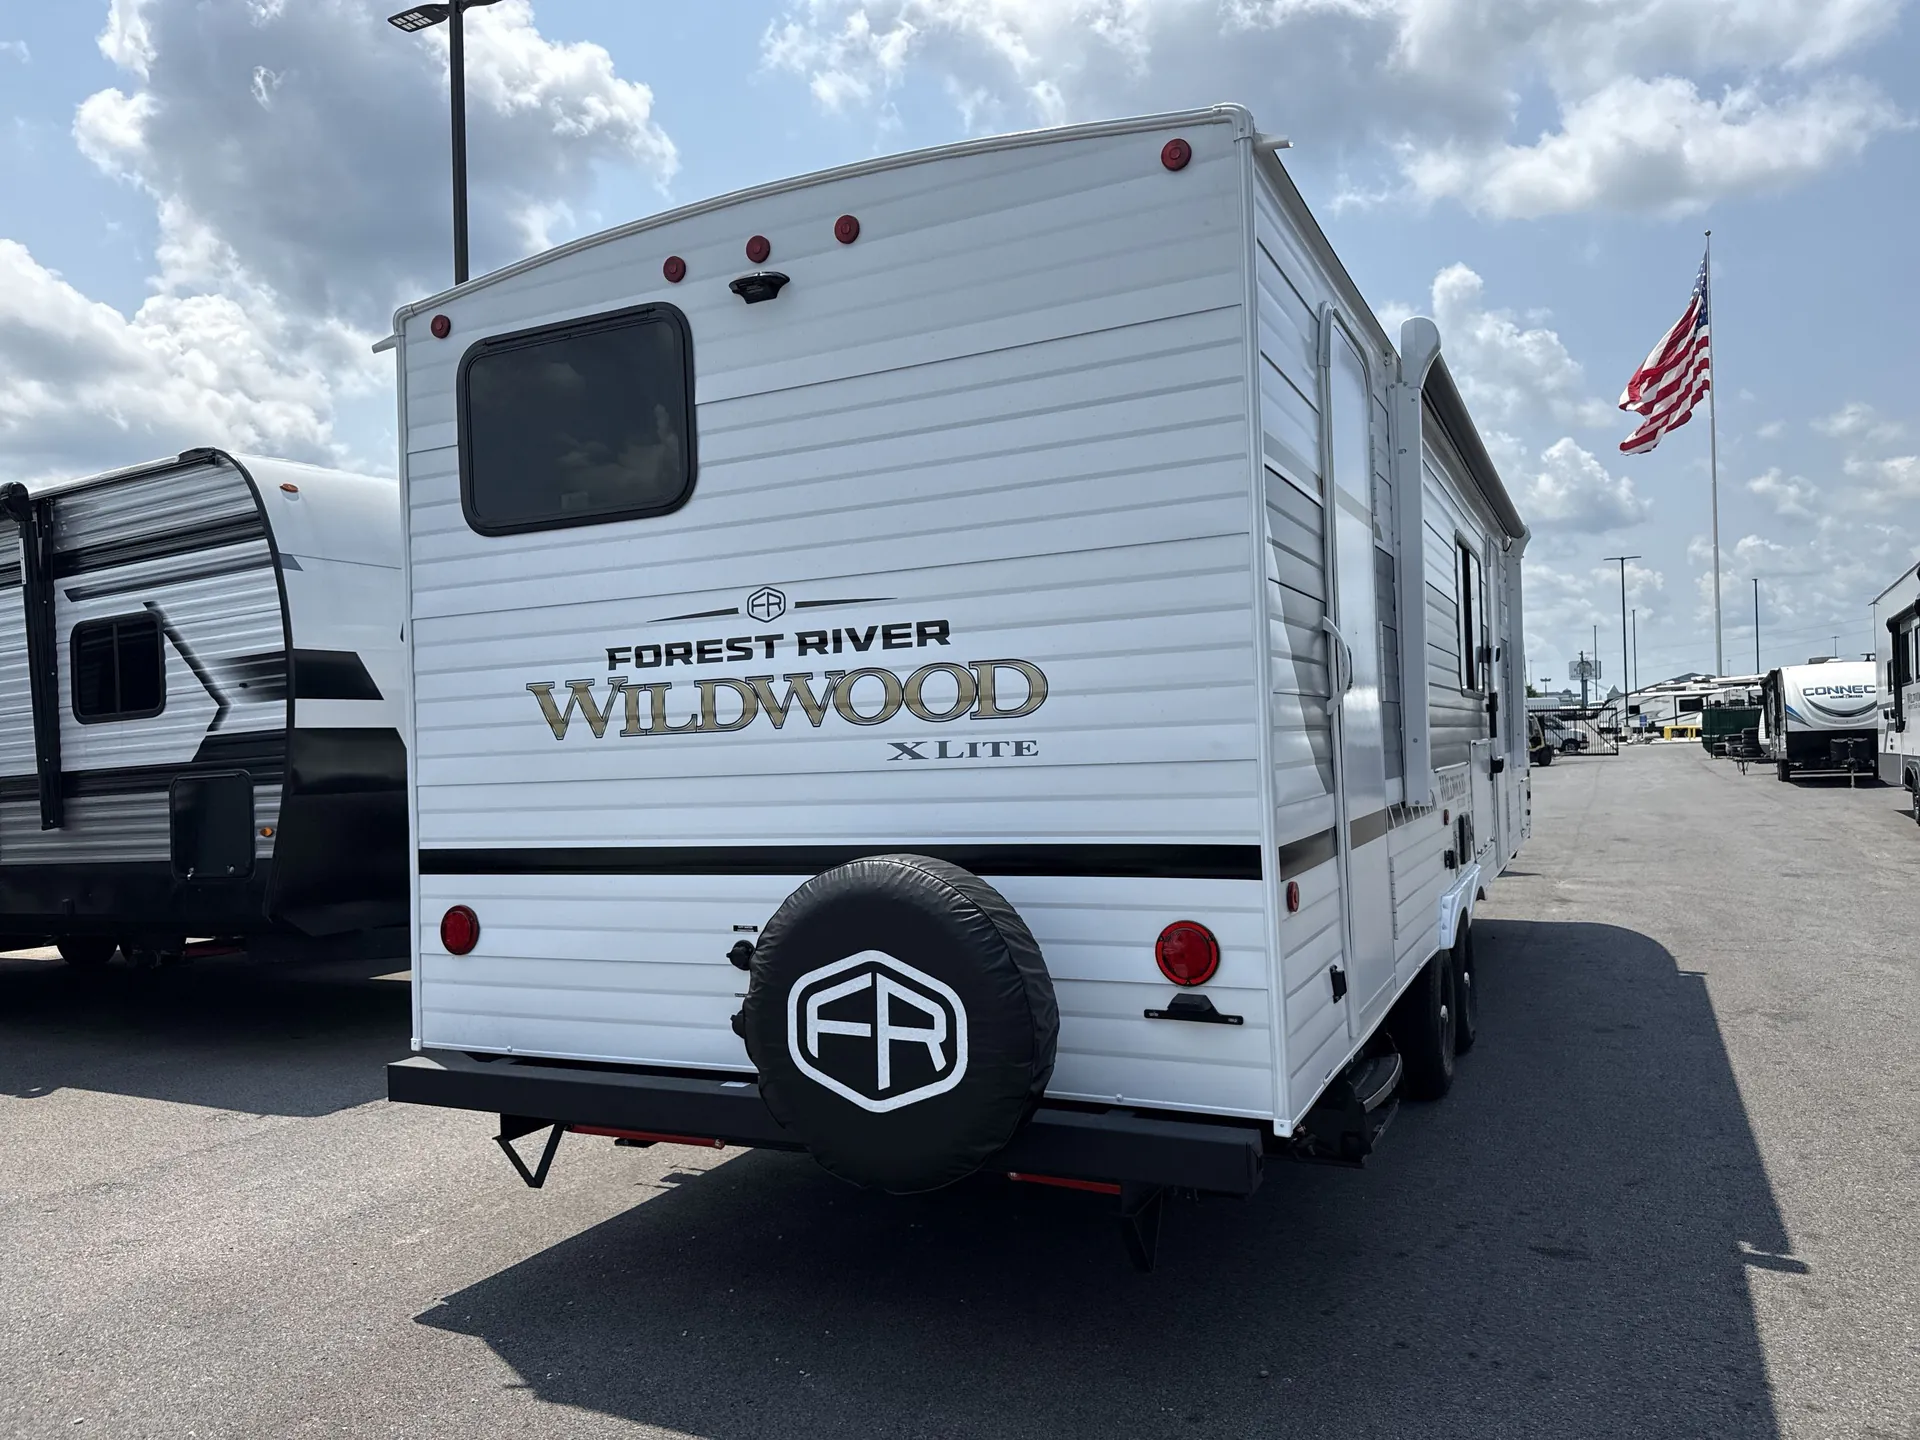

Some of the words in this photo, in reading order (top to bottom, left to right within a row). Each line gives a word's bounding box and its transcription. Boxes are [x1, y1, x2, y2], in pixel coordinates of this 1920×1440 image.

[605, 633, 784, 671] FOREST
[794, 619, 951, 657] RIVER
[526, 658, 1049, 741] WILDWOOD
[886, 741, 928, 761] X
[934, 739, 1039, 760] LITE
[806, 971, 947, 1091] FR
